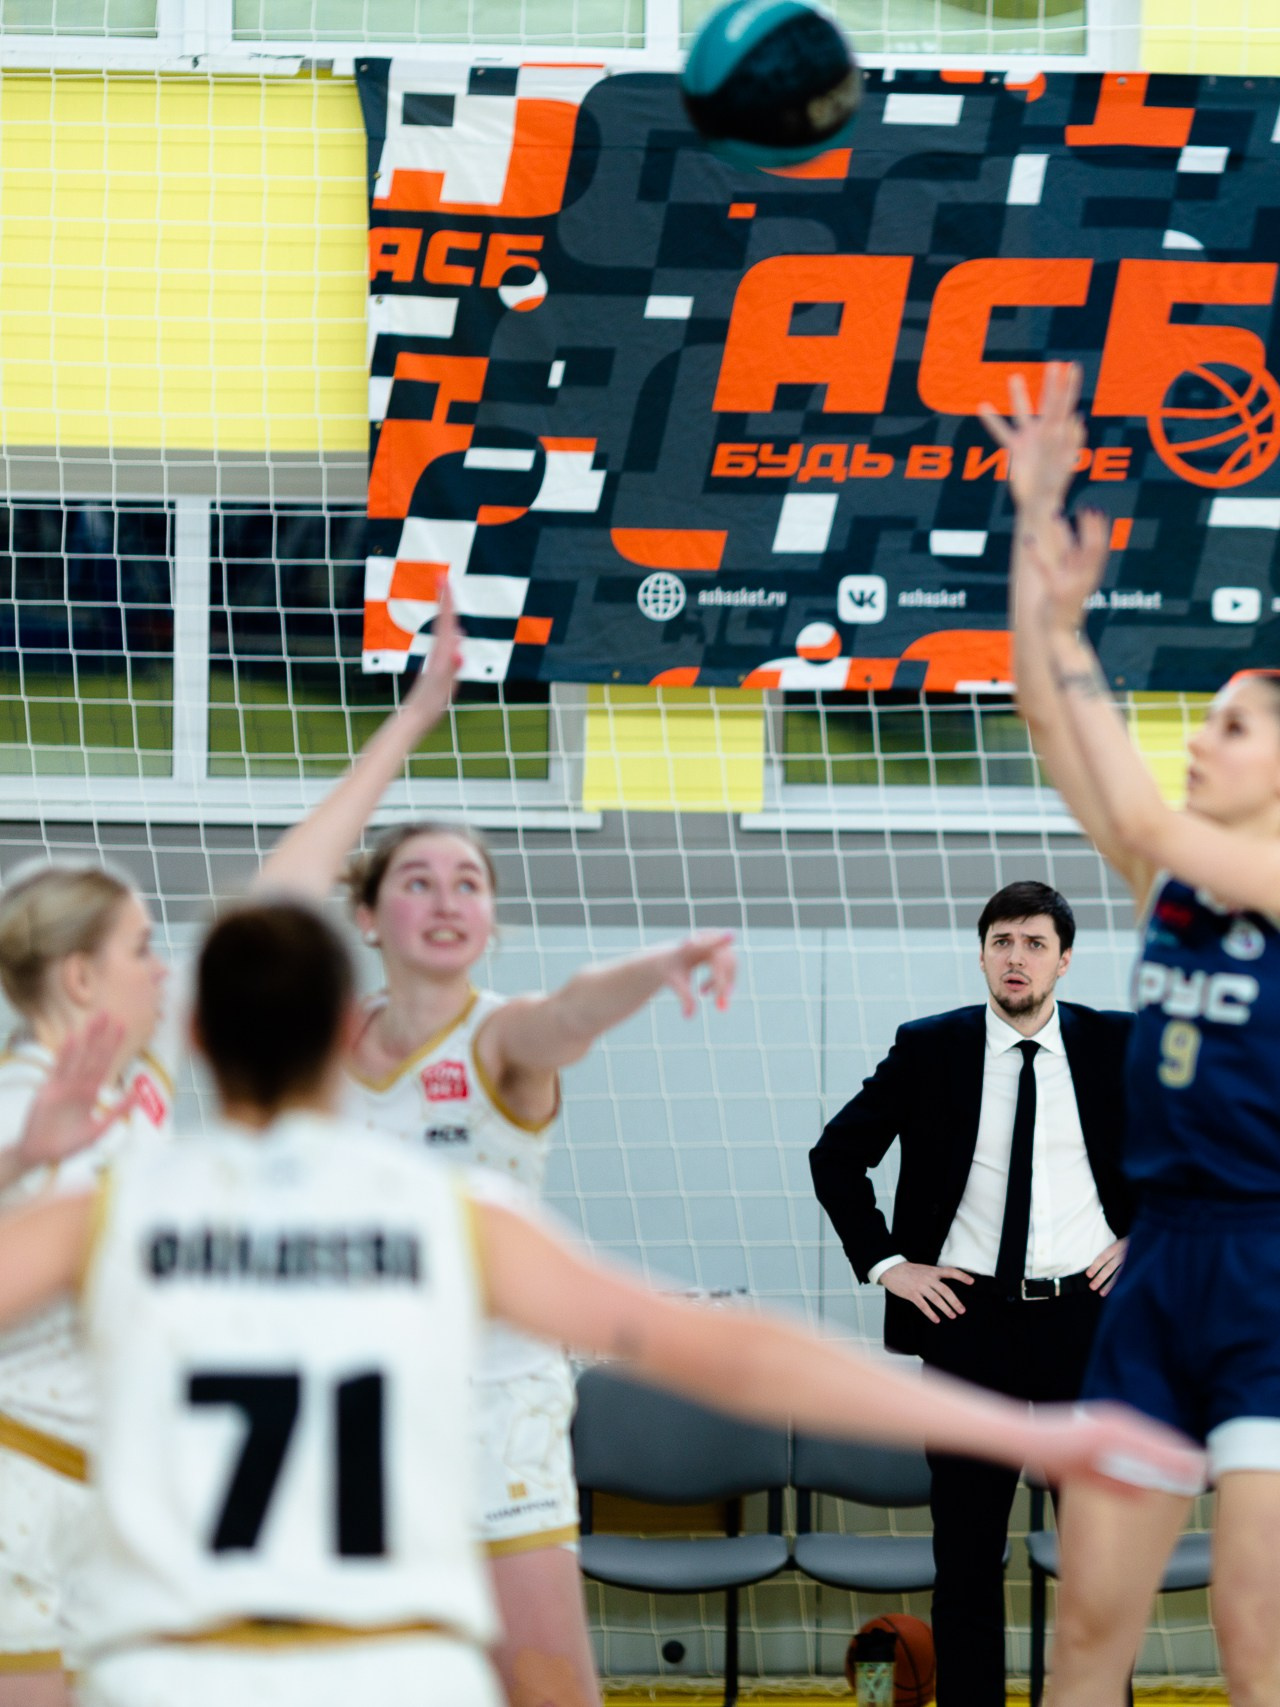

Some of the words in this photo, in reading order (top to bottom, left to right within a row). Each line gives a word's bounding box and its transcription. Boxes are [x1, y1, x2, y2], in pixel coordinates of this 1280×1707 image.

[369, 226, 544, 288] АСБ
[711, 254, 1279, 418] АСБ
[711, 443, 895, 483] БУДЬ
[903, 445, 953, 480] В
[961, 446, 1132, 482] ИРЕ
[698, 586, 788, 608] asbasket.ru
[898, 588, 967, 608] asbasket
[1134, 961, 1258, 1026] РУС
[1158, 1021, 1202, 1089] 9
[184, 1364, 388, 1561] 71
